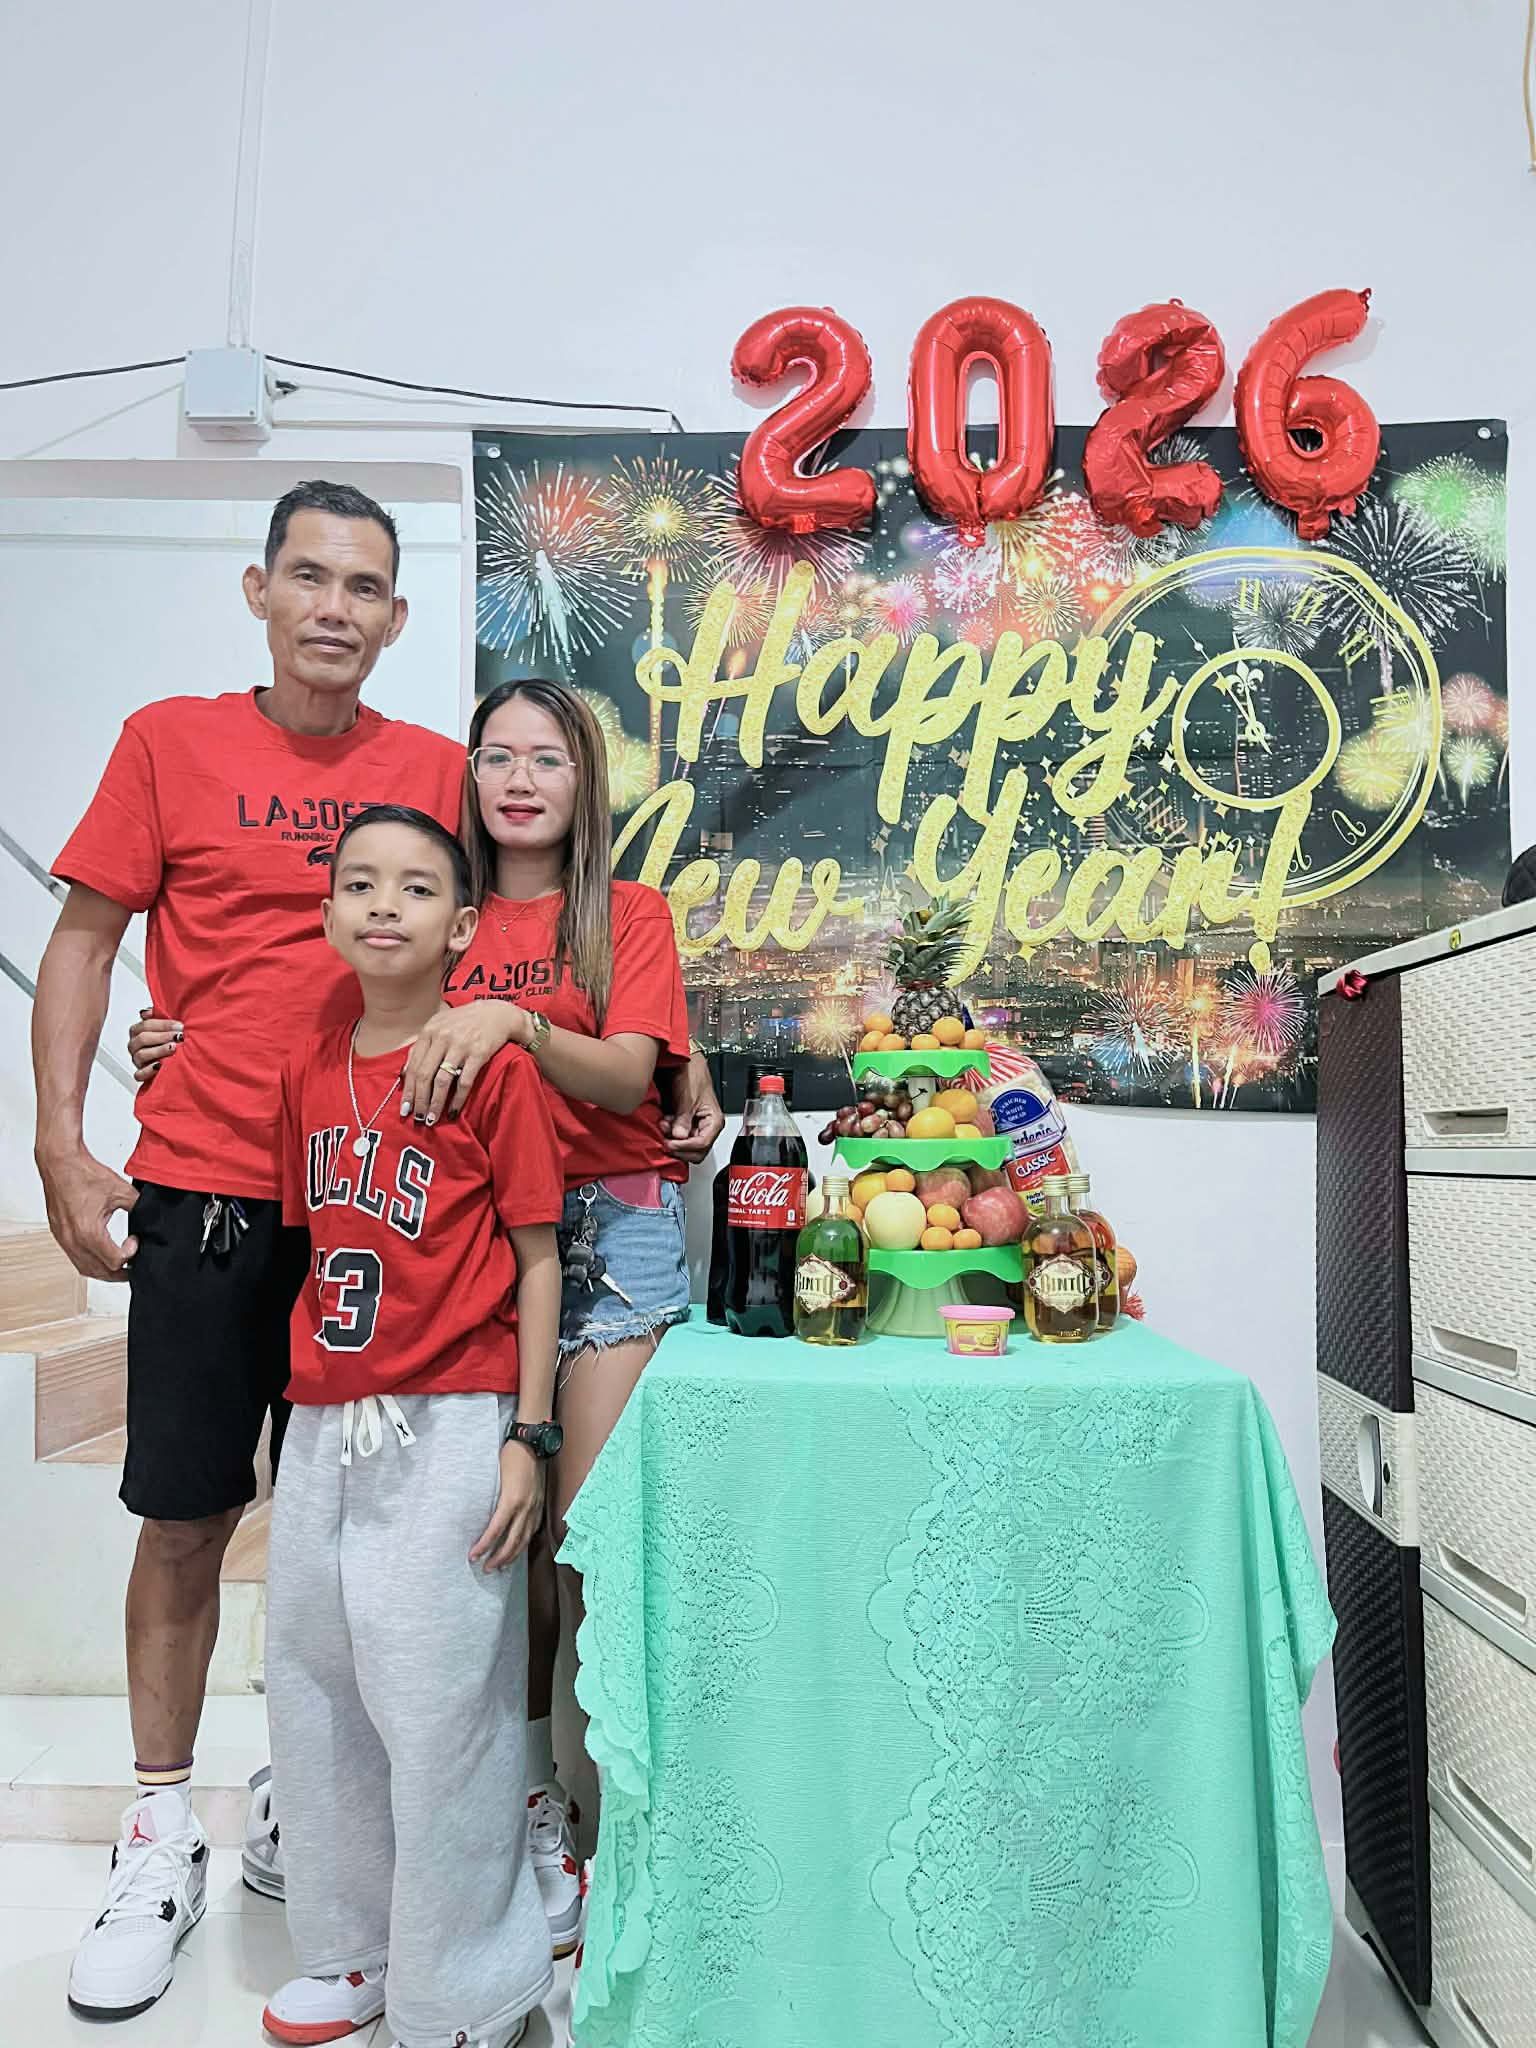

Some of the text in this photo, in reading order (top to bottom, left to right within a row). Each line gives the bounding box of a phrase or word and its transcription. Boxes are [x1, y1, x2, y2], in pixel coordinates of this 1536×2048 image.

[731, 287, 1383, 541] 2026
[635, 559, 1181, 825] Happy
[237, 794, 386, 832] LACOS
[913, 767, 1313, 989] Year!
[306, 1125, 435, 1241] ULLS
[1015, 1150, 1057, 1178] CLASSIC
